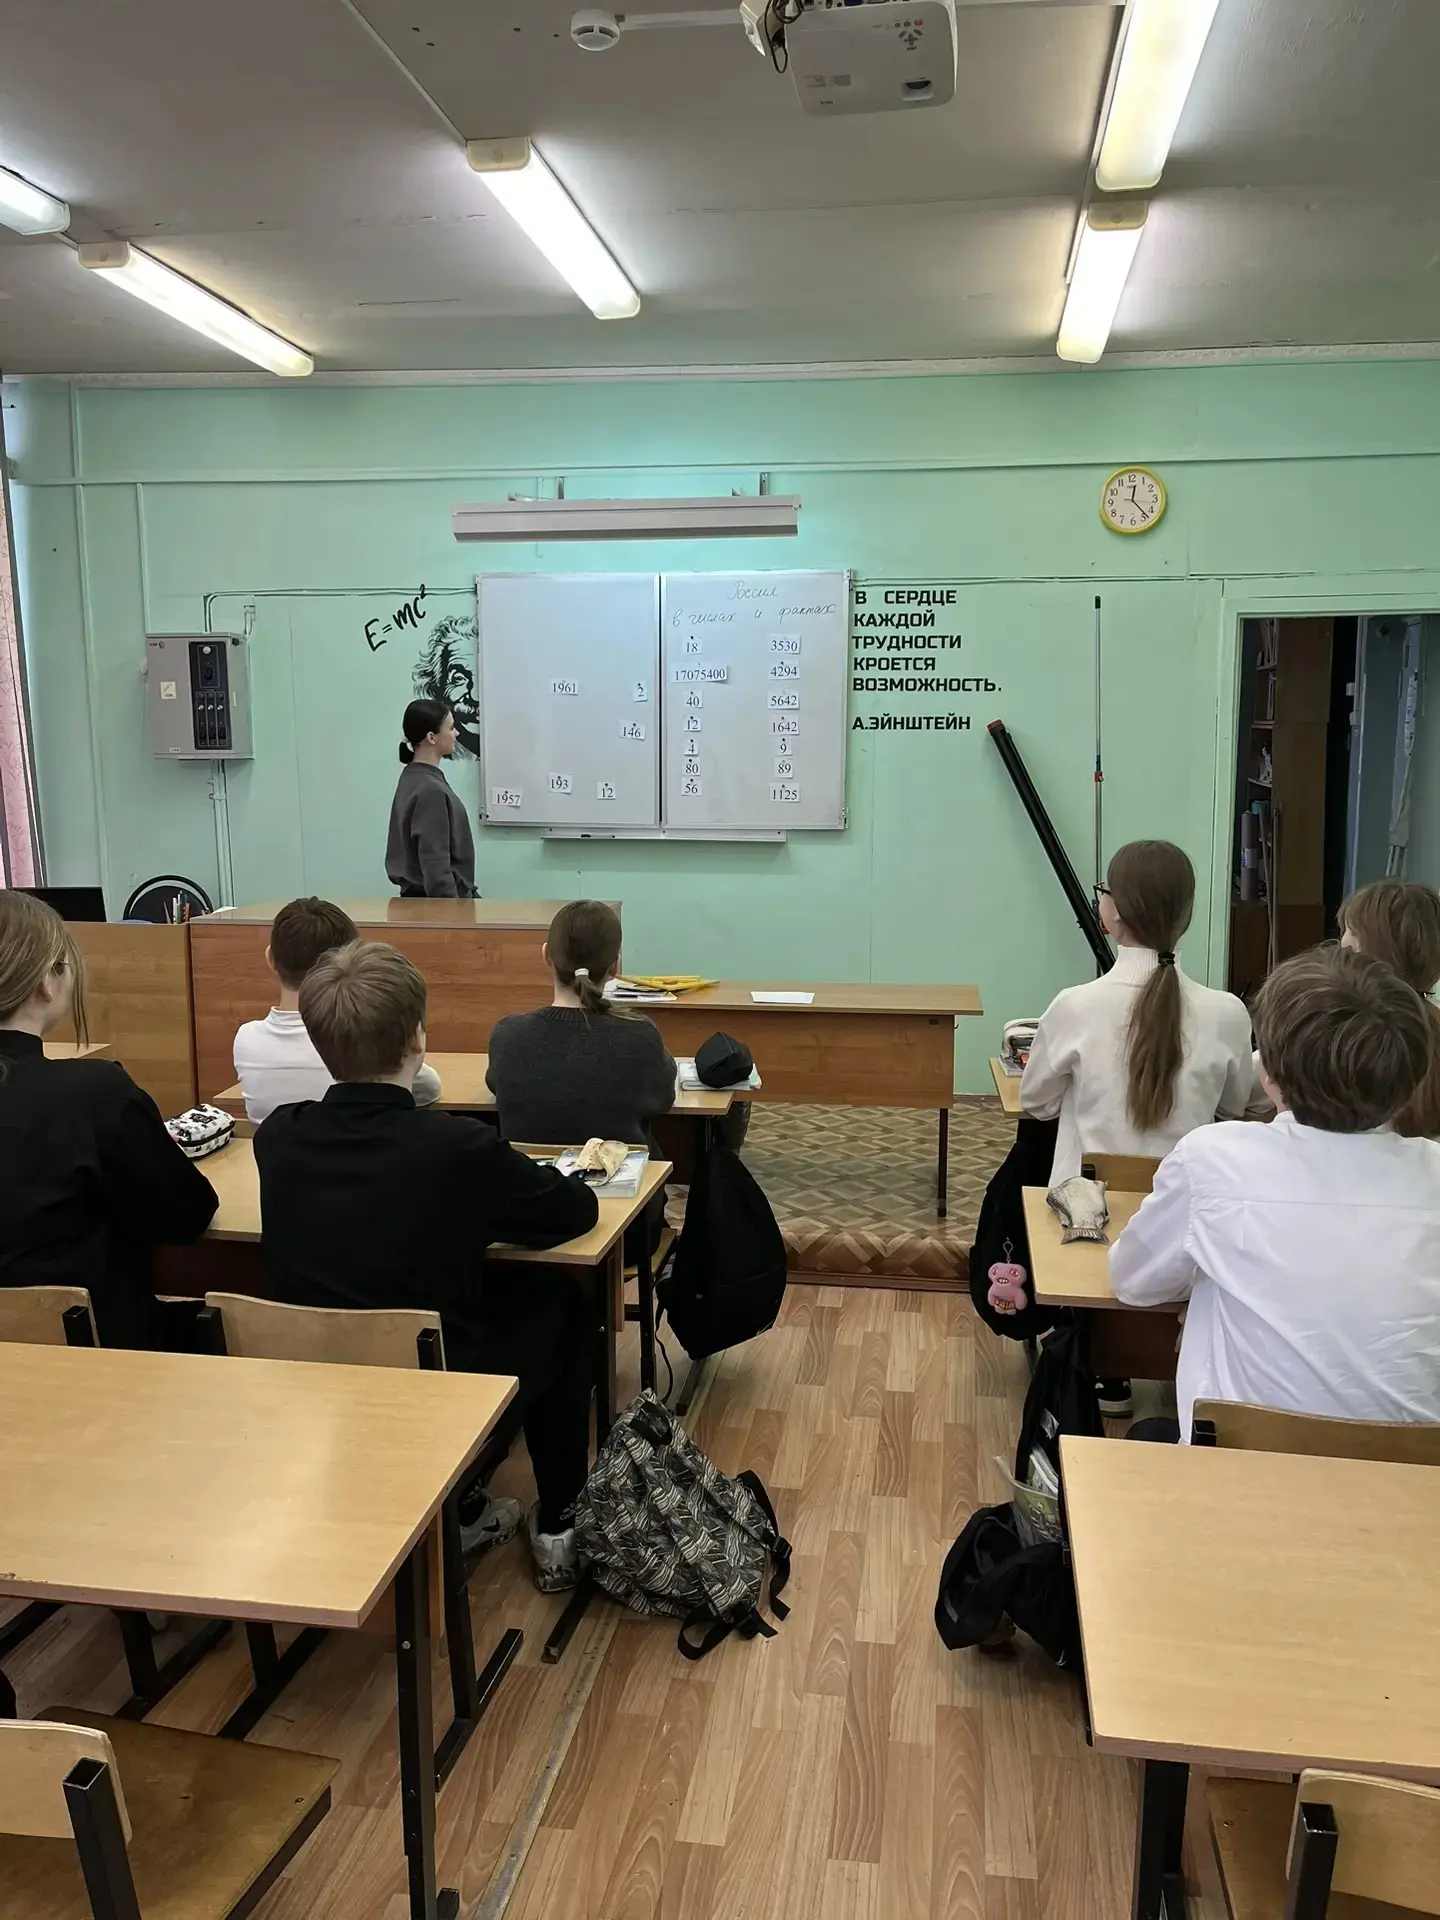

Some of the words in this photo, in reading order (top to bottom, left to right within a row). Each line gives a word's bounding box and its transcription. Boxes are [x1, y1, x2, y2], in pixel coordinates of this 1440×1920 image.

[1118, 479, 1124, 487] 11
[1128, 474, 1136, 482] 12
[1110, 488, 1118, 496] 10
[1148, 484, 1154, 492] 2
[1108, 499, 1114, 507] 9
[1152, 494, 1158, 503] 3
[1111, 509, 1117, 517] 8
[1148, 506, 1154, 514] 4
[1130, 517, 1136, 526] 6
[727, 580, 777, 600] Россия
[855, 591, 867, 604] В
[884, 590, 957, 606] СЕРДЦЕ
[673, 607, 683, 628] в
[755, 609, 764, 618] и
[779, 603, 837, 625] фактах
[854, 609, 935, 629] КАЖДОЙ
[686, 642, 698, 652] 18
[770, 640, 798, 652] 3530
[852, 635, 961, 651] ТРУДНОСТИ
[853, 657, 936, 671] КРОЕТСЯ
[675, 669, 726, 681] 17075400
[770, 666, 798, 677] 4294
[553, 683, 576, 693] 1961
[853, 678, 1002, 692] ВОЗМОЖНОСТЬ.
[638, 686, 644, 697] 2
[686, 696, 700, 707] 40
[770, 695, 798, 706] 5642
[686, 720, 698, 730] 12
[772, 722, 798, 732] 1642
[852, 713, 971, 730] А.ЭЙНШТЕЙН
[623, 727, 641, 738] 146
[688, 744, 694, 754] 4
[780, 743, 787, 754] 9
[686, 764, 698, 774] 80
[778, 763, 792, 774] 89
[551, 779, 568, 790] 193
[684, 784, 698, 794] 56
[602, 788, 613, 798] 12
[772, 790, 798, 800] 1125
[496, 794, 520, 805] 1957
